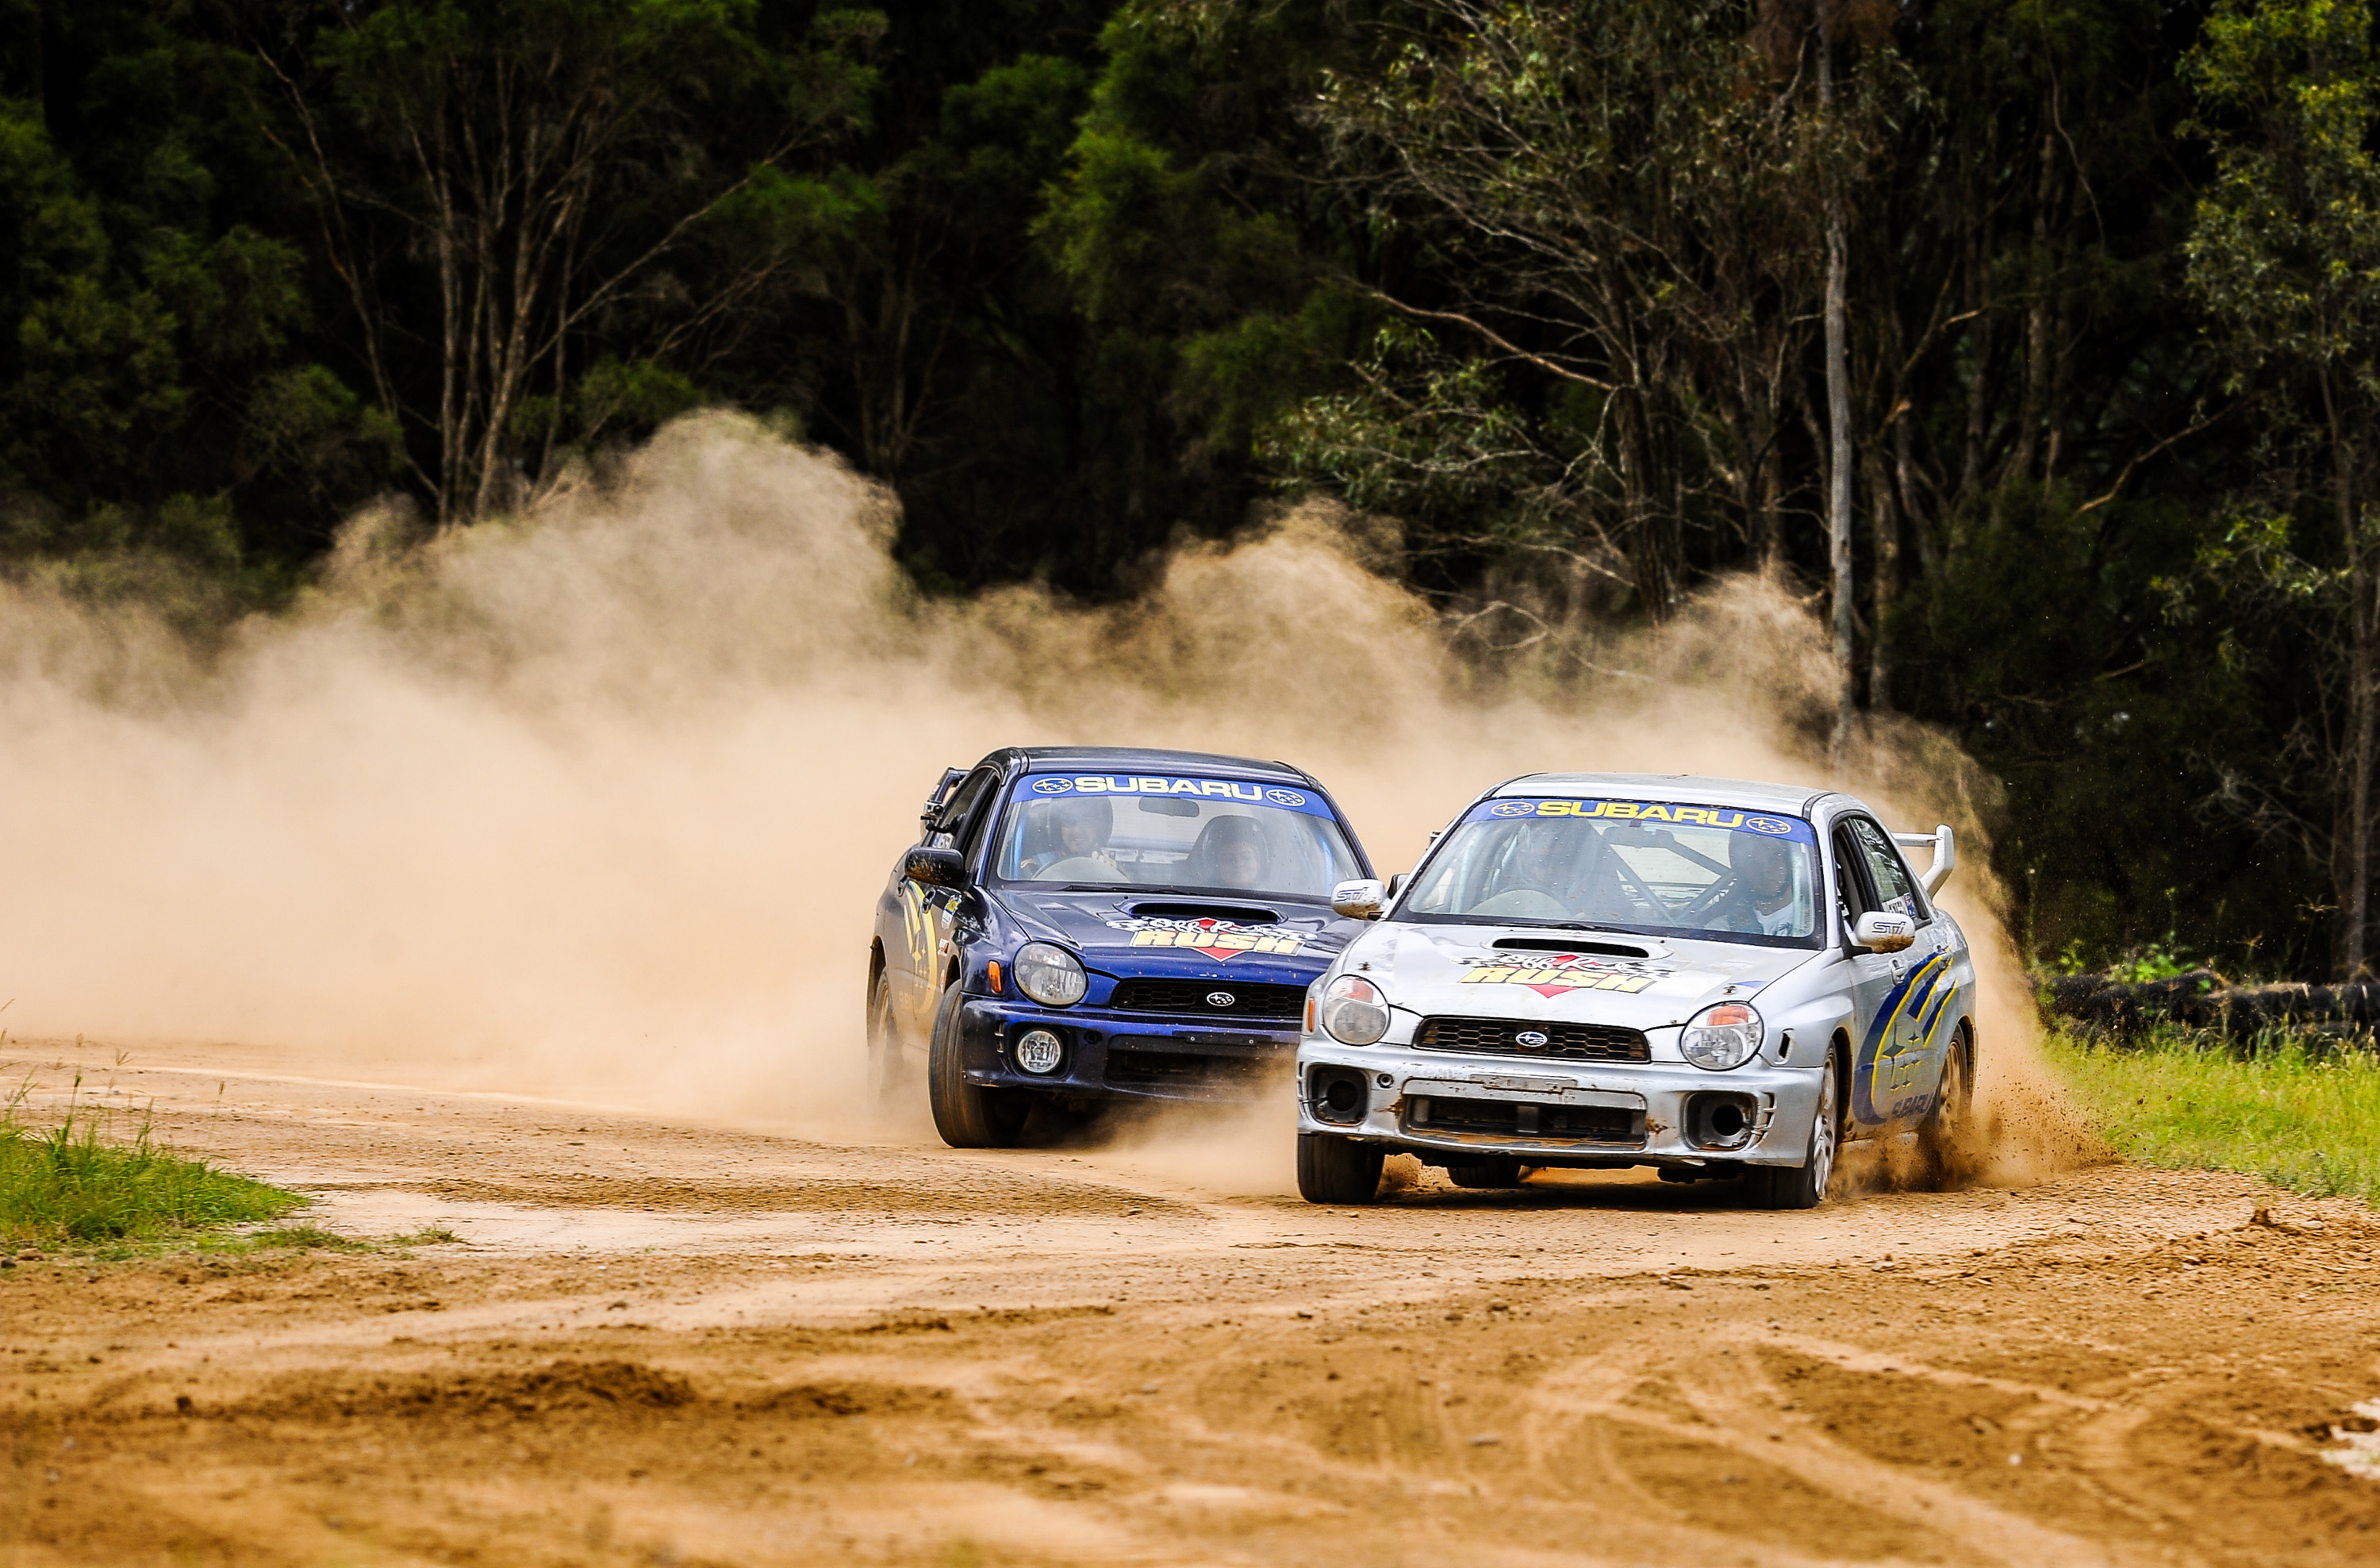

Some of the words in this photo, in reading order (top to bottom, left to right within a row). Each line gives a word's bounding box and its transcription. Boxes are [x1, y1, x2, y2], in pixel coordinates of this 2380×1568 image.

[1075, 777, 1262, 801] SUBARU
[1535, 801, 1745, 828] SUBARU
[1132, 930, 1303, 956] RUSH
[1458, 966, 1655, 993] RUSH
